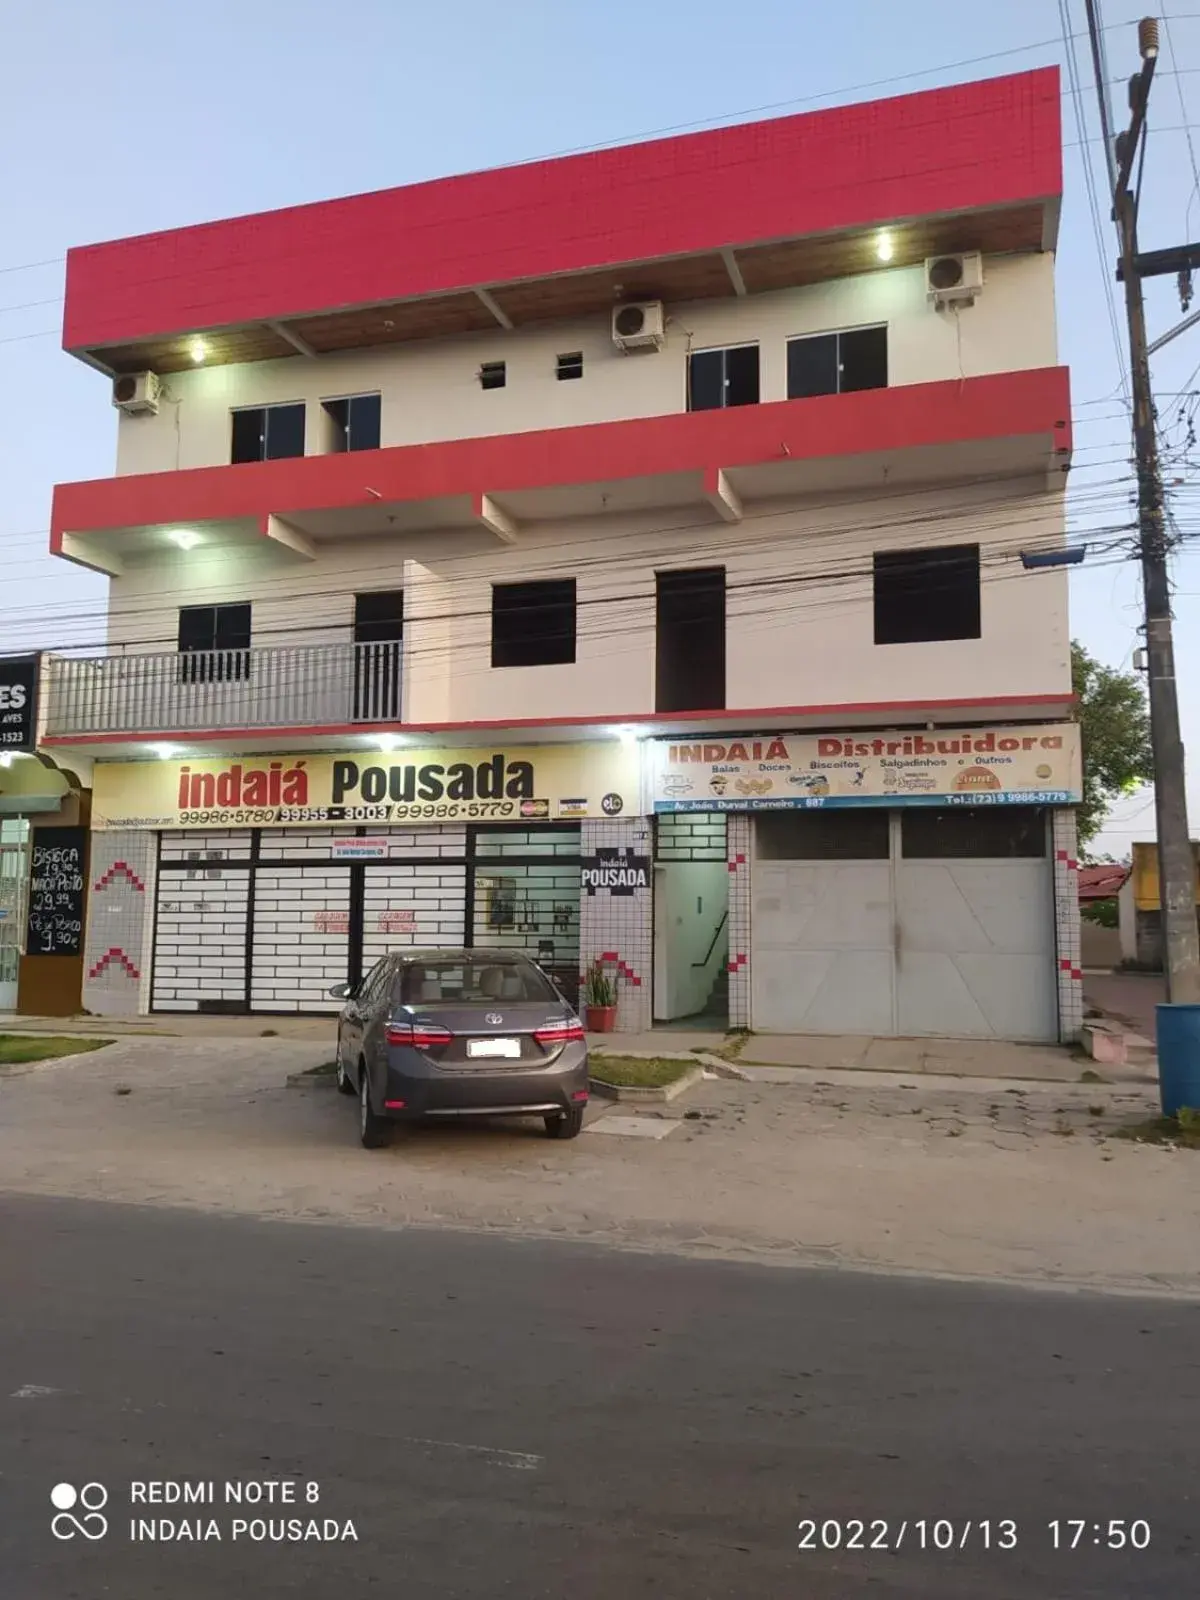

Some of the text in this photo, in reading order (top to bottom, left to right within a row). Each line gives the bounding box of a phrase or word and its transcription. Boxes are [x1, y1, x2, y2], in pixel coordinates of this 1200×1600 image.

[668, 733, 1063, 762] INDAIÁ Distribuidora
[711, 765, 740, 774] Balas
[759, 763, 792, 772] Doces
[809, 760, 860, 770] Biscoitos
[880, 759, 947, 769] Salgadinhos
[975, 757, 1012, 765] Outros
[178, 755, 534, 809] indaiá Pousada
[718, 800, 749, 809] Durval
[752, 799, 794, 809] Carneiro
[581, 868, 645, 887] POUSADA
